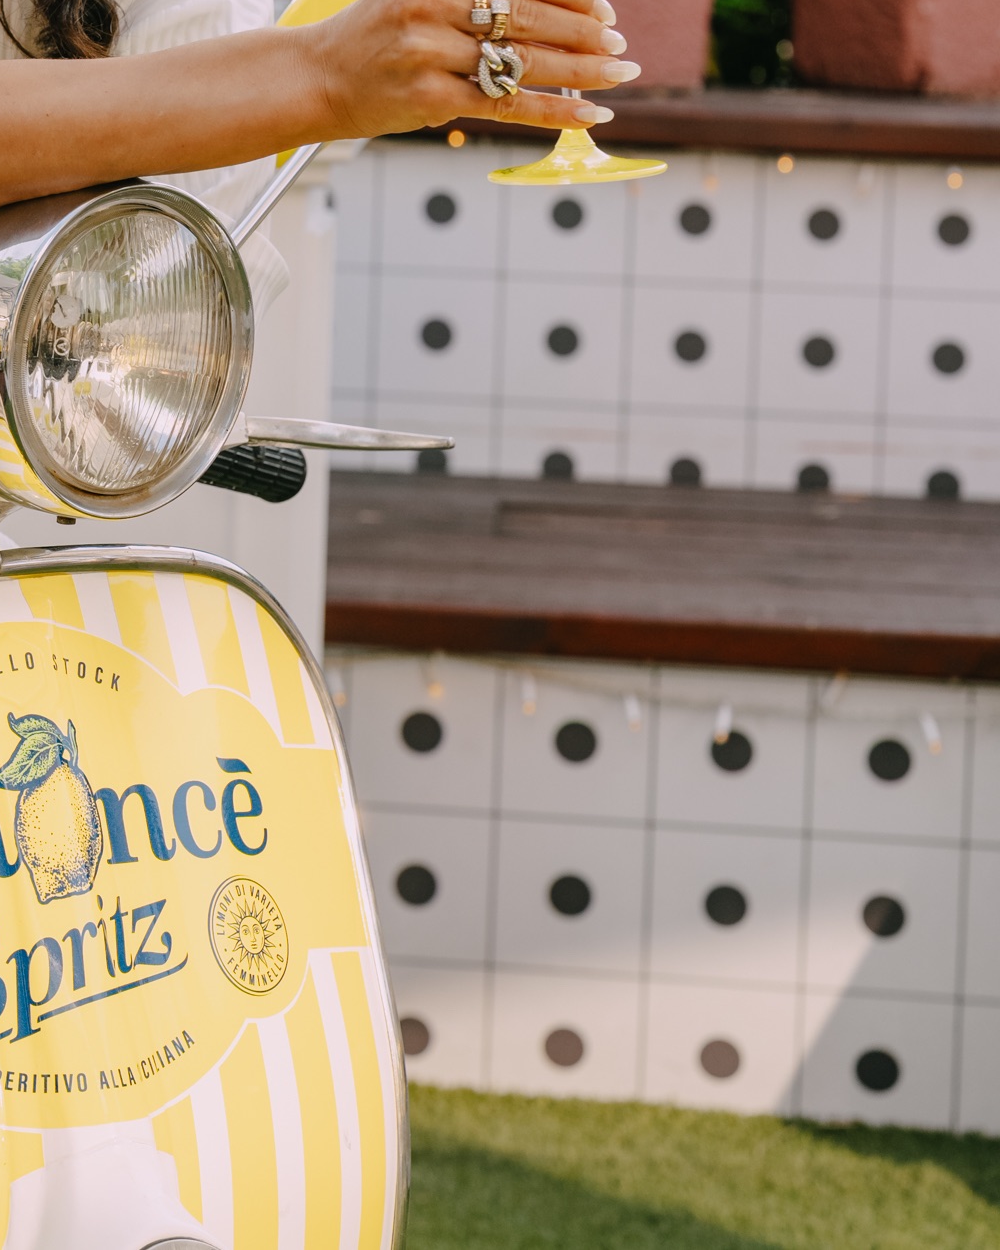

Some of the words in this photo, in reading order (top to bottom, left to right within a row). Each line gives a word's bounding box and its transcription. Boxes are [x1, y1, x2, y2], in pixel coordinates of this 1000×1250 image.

[52, 653, 120, 692] STOCK
[216, 890, 235, 936] LIMONI
[235, 884, 246, 897] DI
[227, 953, 285, 987] FEMMINELLO
[99, 1067, 137, 1090] ALLA
